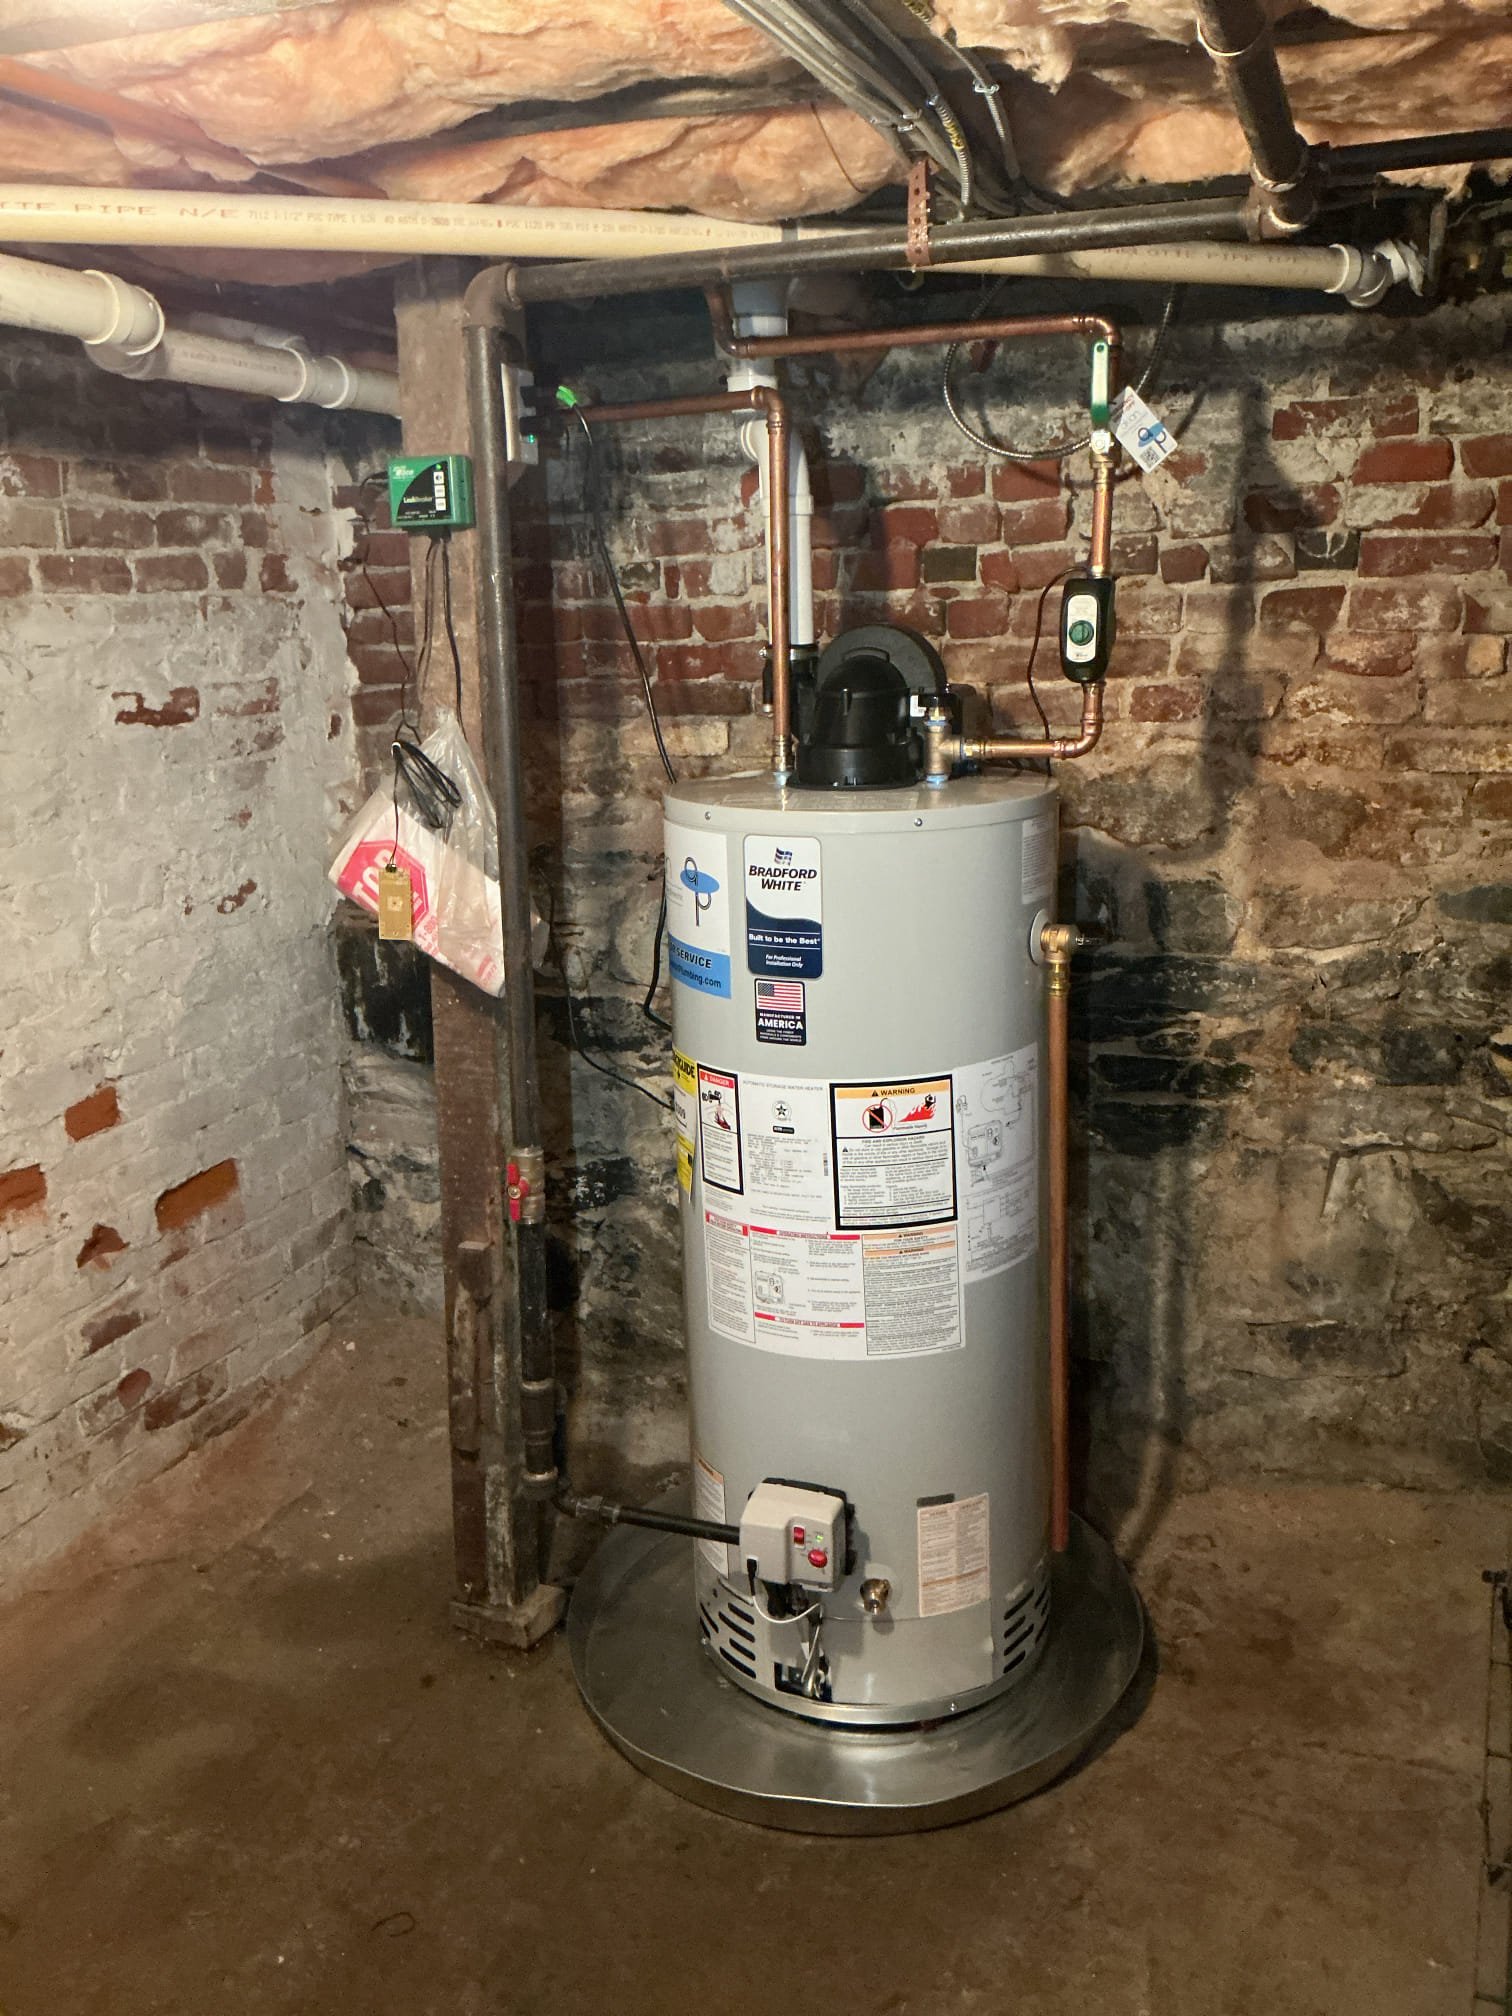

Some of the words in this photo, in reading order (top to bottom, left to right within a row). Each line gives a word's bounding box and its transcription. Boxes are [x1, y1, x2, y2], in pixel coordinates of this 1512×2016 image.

[75, 203, 157, 216] PIPE
[749, 865, 818, 879] BRADFORD
[761, 878, 802, 891] WHITE
[749, 933, 764, 942] Built
[774, 935, 784, 944] be
[785, 936, 797, 945] the
[677, 947, 712, 969] SERVICE
[758, 1018, 804, 1030] AMERICA
[709, 1075, 730, 1086] DANGER
[880, 1087, 916, 1097] WARNING
